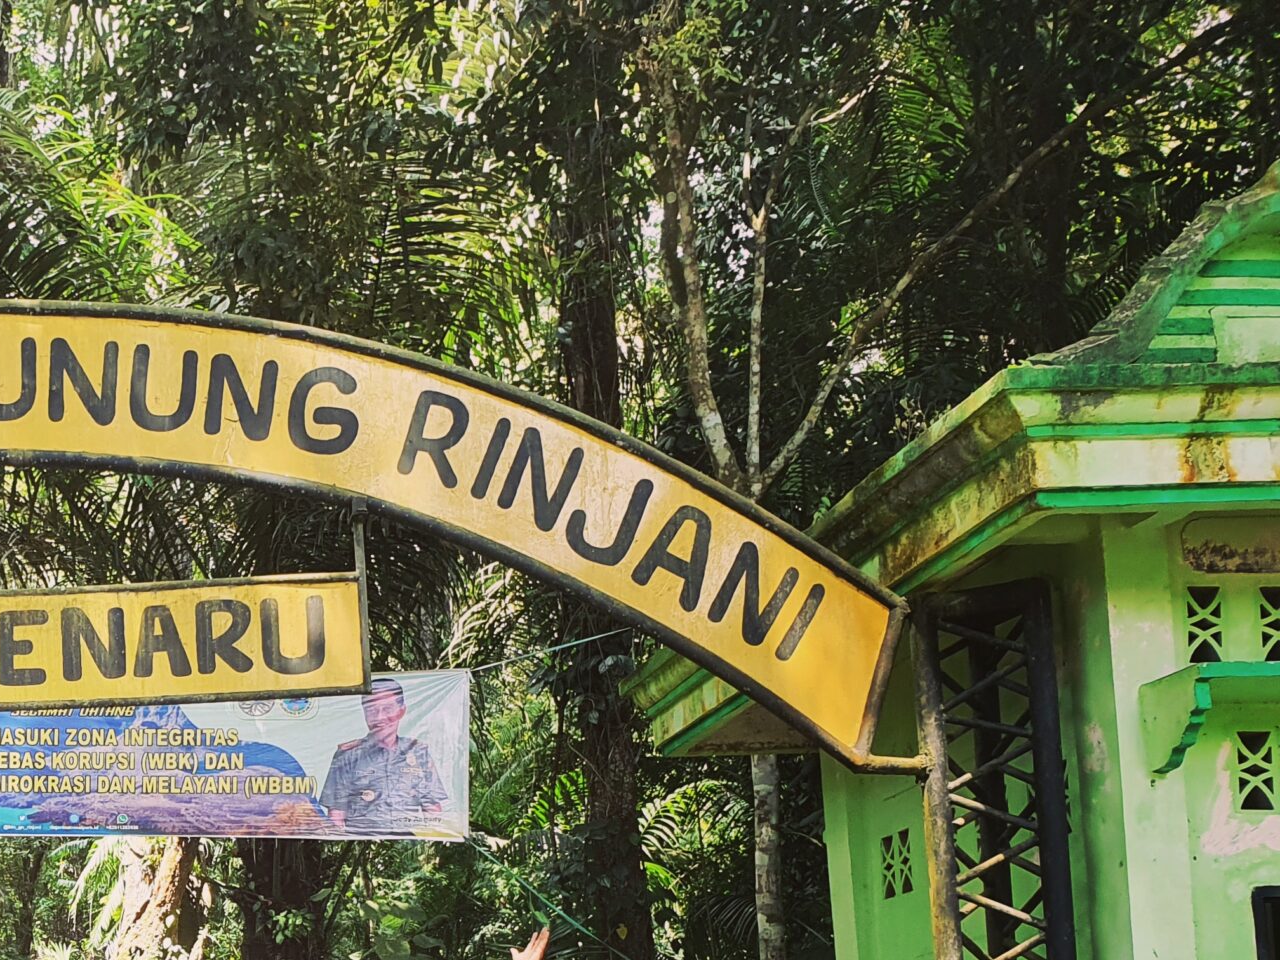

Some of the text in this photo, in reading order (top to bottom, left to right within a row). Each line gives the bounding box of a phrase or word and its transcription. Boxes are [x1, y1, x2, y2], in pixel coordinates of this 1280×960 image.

[397, 389, 826, 662] RINJANI
[65, 728, 118, 747] ZONA
[123, 728, 239, 747] INTEGRITAS
[51, 752, 136, 770] KORUPSI
[141, 752, 198, 773] (WBK)
[204, 752, 244, 770] DAN
[97, 775, 136, 793] DAN
[141, 775, 238, 794] MELAYANI
[244, 775, 319, 799] (WBBM)
